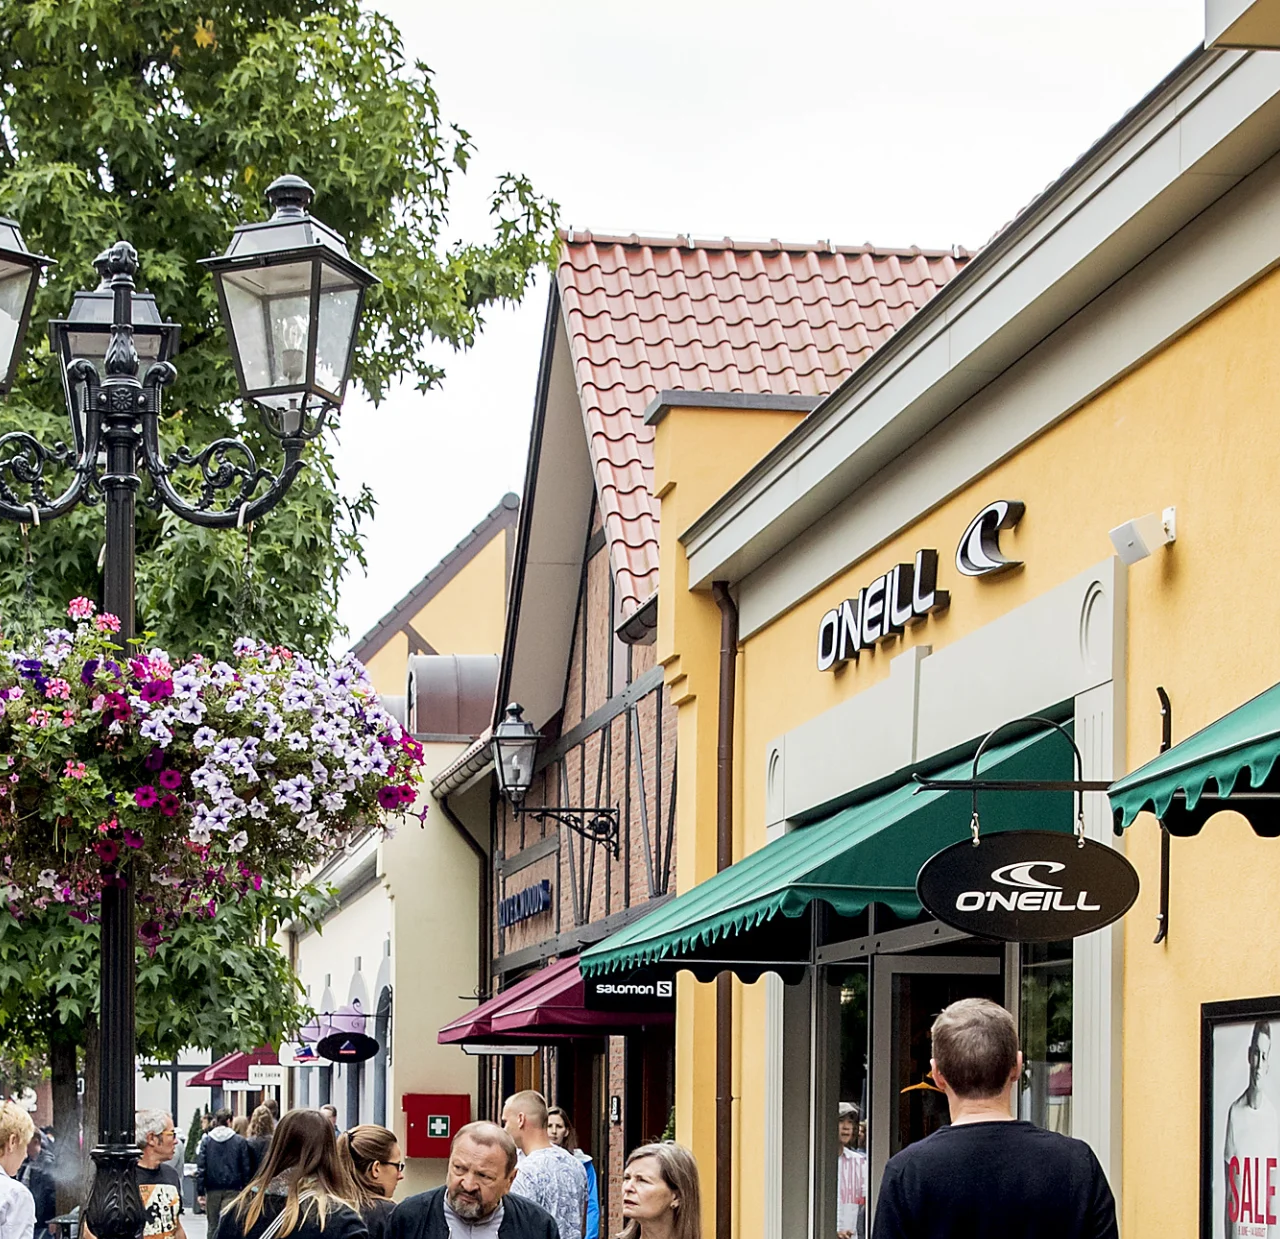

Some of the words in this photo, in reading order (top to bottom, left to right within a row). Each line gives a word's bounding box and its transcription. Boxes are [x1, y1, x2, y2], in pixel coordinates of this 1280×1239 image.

[817, 549, 950, 672] O'NEILL
[956, 891, 1101, 912] O'NEILL
[1228, 1155, 1277, 1225] SALE
